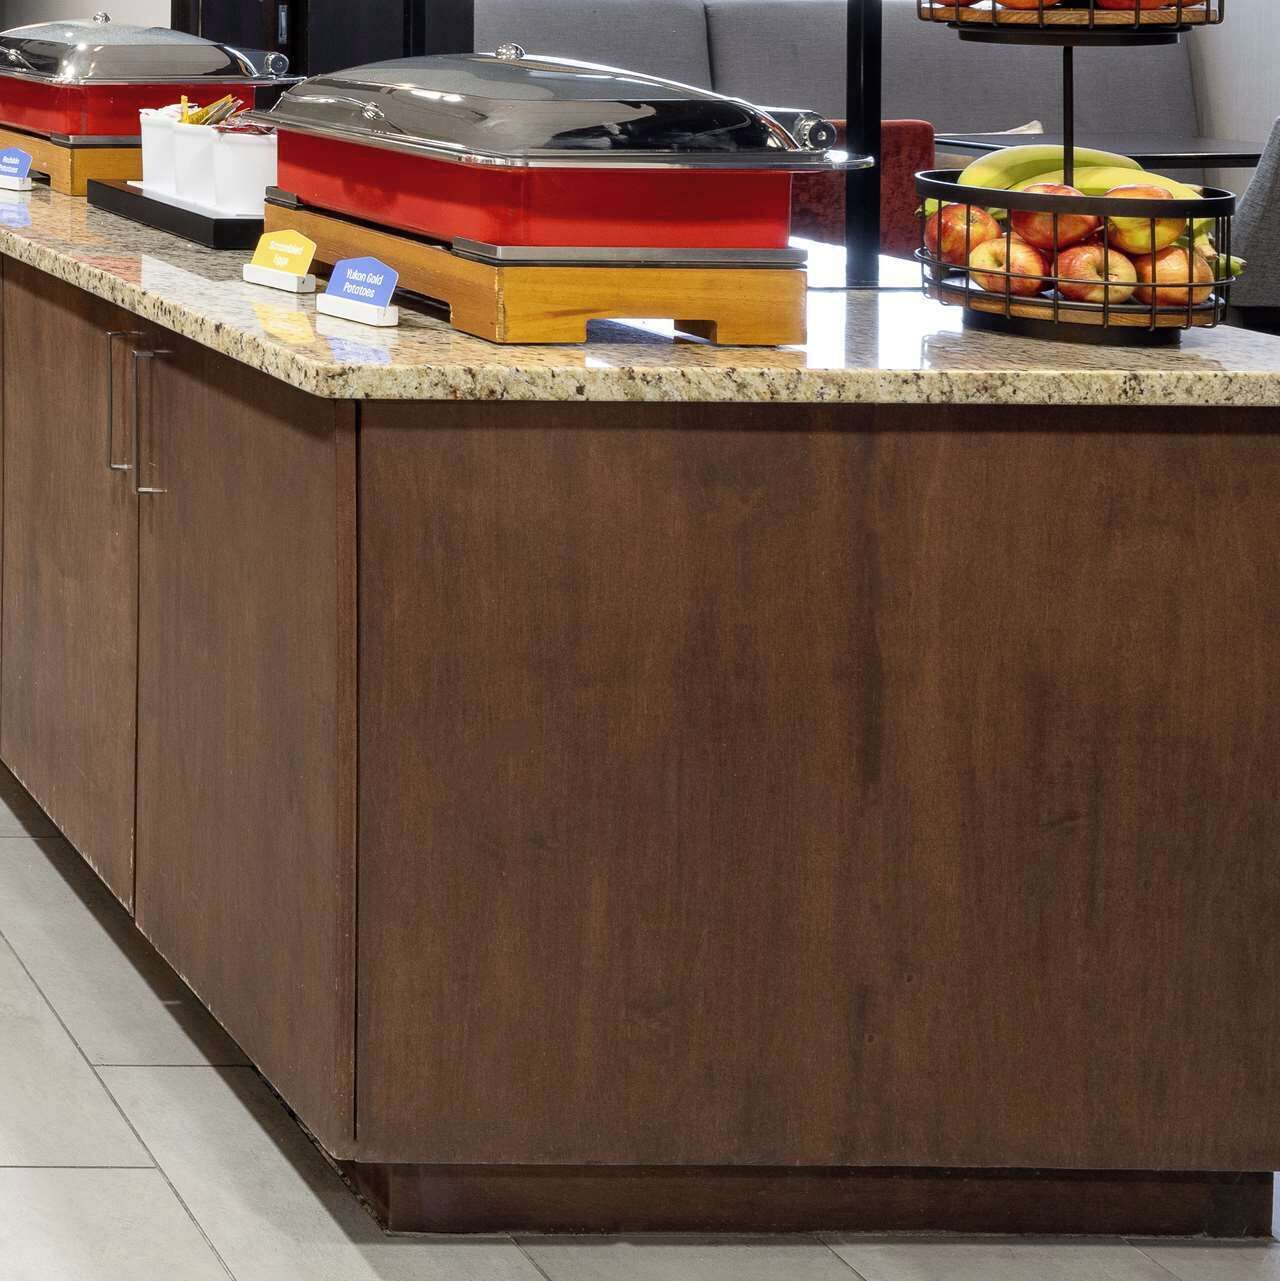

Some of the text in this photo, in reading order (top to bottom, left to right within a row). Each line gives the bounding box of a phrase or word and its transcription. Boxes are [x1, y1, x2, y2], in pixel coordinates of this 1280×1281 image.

[346, 268, 384, 286] Yukon Gold
[343, 281, 376, 298] Potatoes
